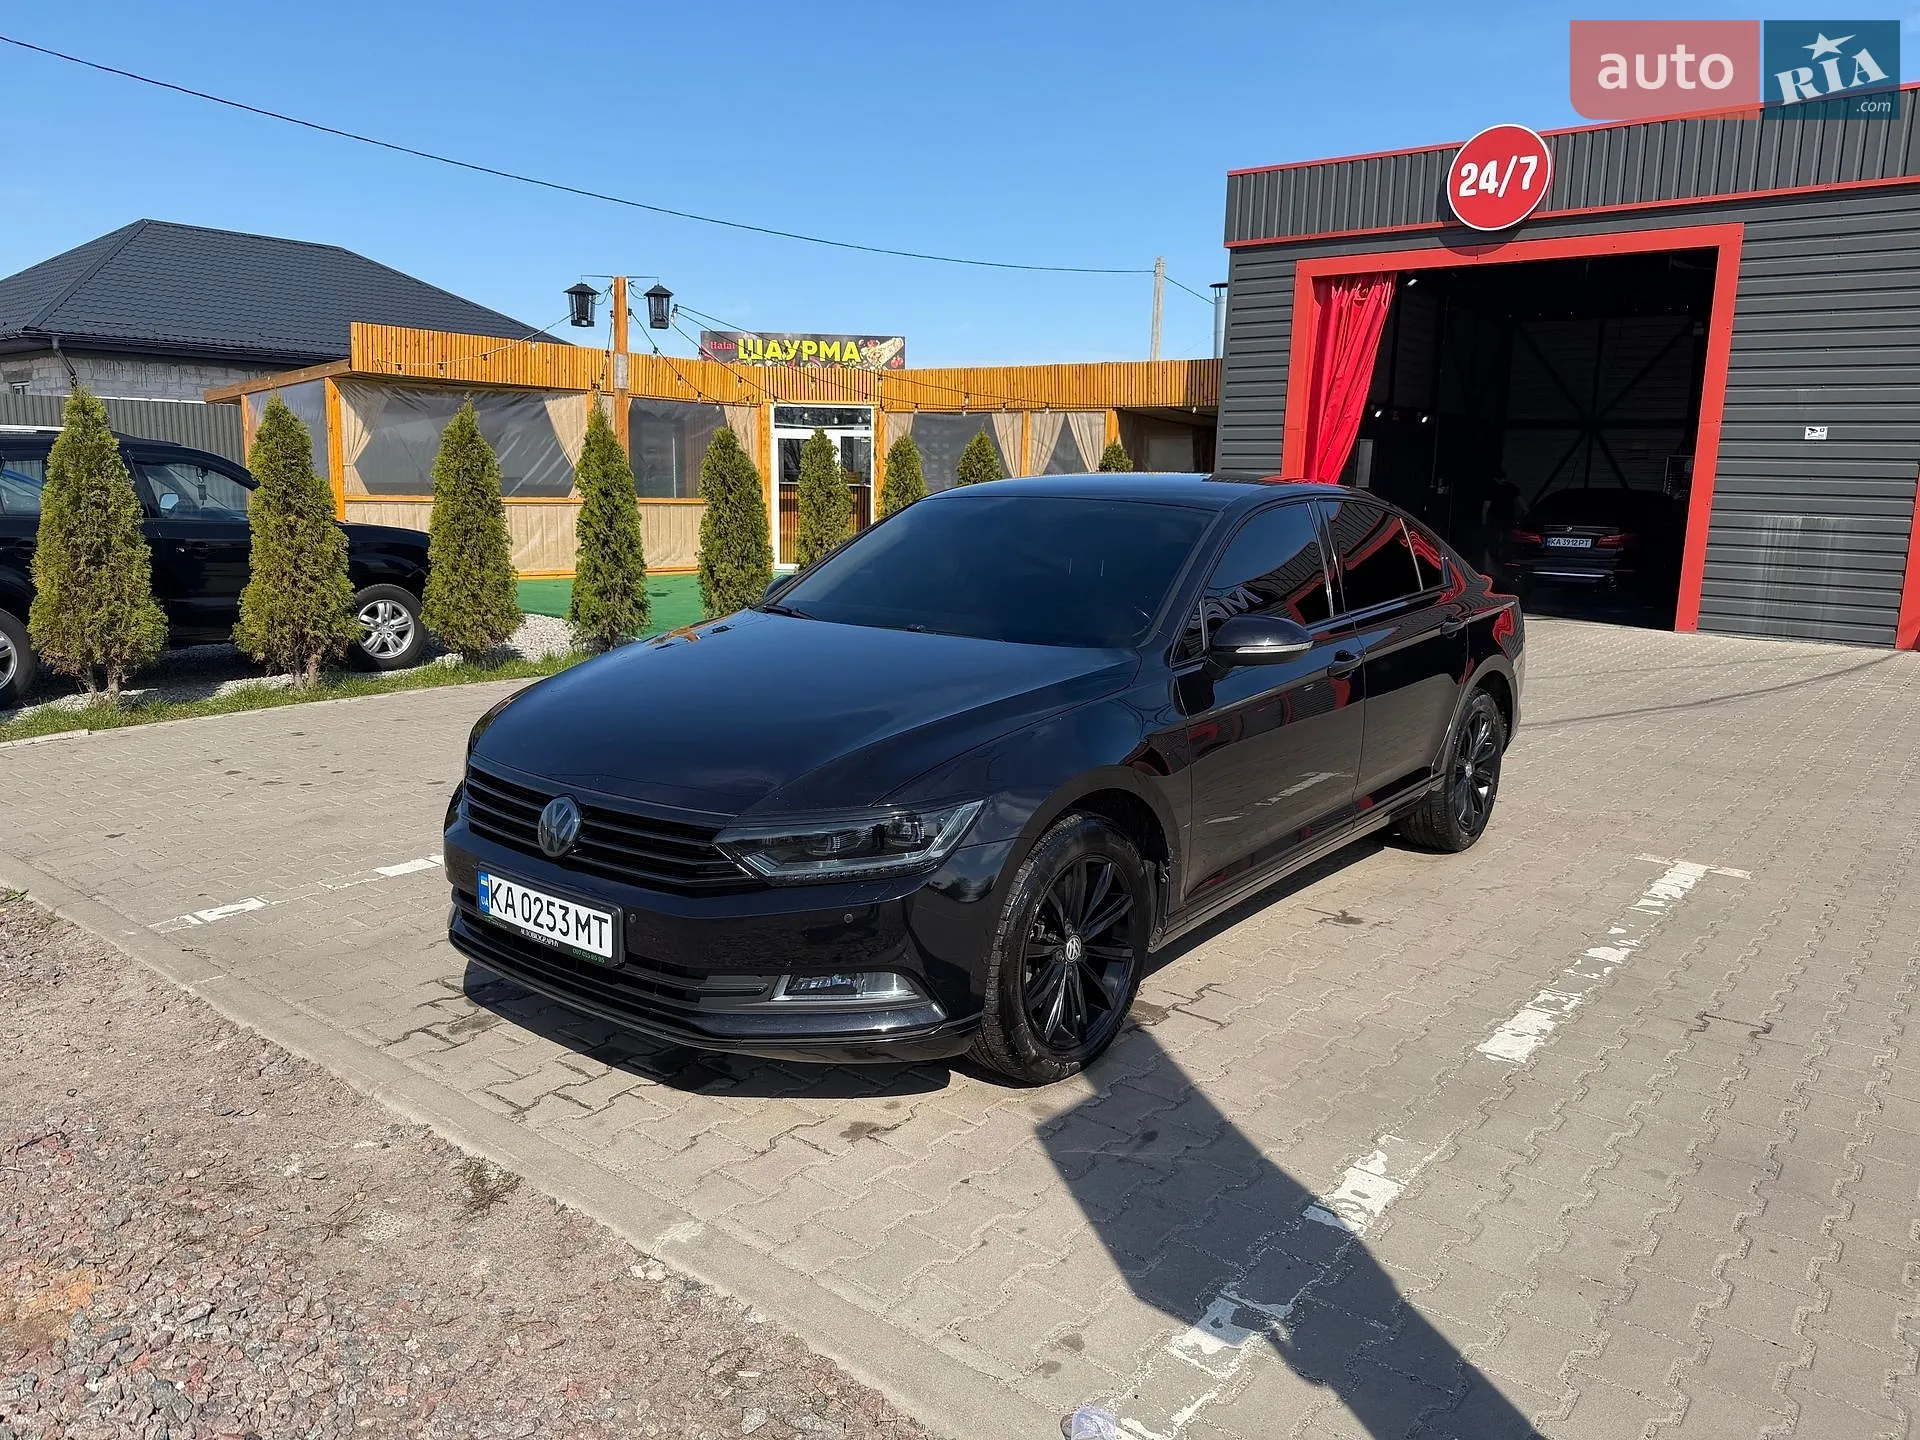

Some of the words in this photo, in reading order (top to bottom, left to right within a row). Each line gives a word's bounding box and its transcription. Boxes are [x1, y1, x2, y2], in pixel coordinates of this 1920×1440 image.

[1458, 155, 1539, 198] 24/7
[710, 340, 736, 351] Halal
[737, 337, 862, 363] ШАУРМА
[490, 879, 517, 919] KA
[521, 892, 570, 937] 0253
[575, 909, 609, 949] MT
